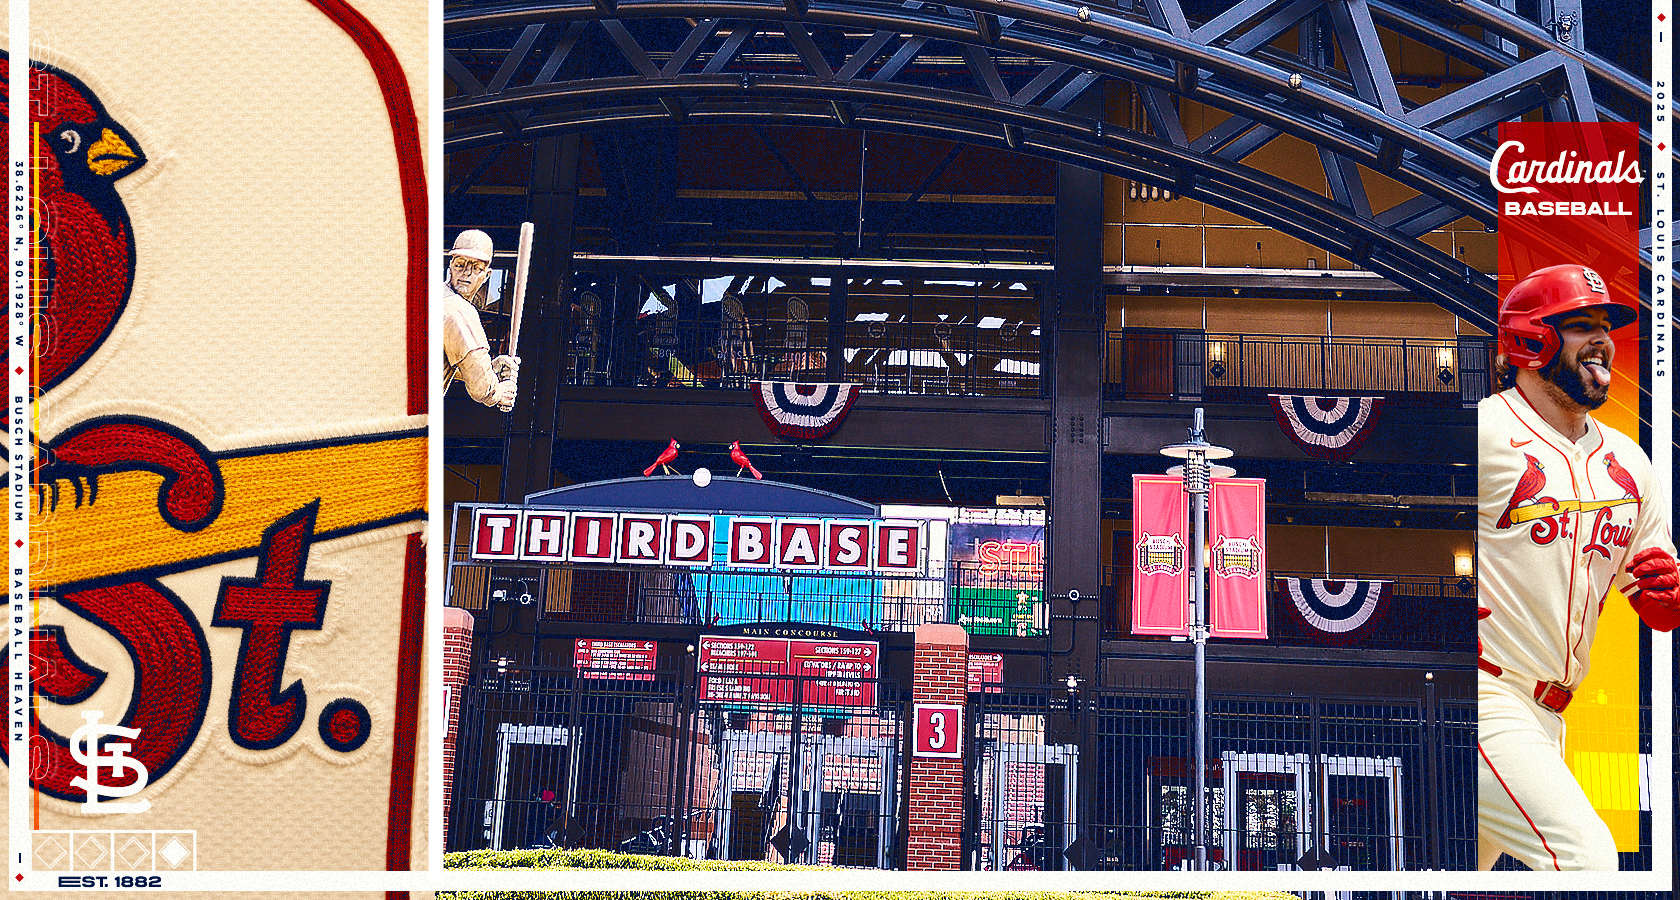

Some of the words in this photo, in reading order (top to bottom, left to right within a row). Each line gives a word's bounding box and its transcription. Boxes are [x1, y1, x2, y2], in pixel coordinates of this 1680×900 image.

[485, 516, 706, 559] THIRD
[738, 524, 909, 565] BASE
[1530, 497, 1573, 545] St.
[1582, 506, 1635, 561] Loui
[742, 627, 770, 635] MAIN
[774, 629, 839, 638] CONCOURSE
[814, 646, 839, 655] SECTIONS
[926, 710, 947, 750] 3
